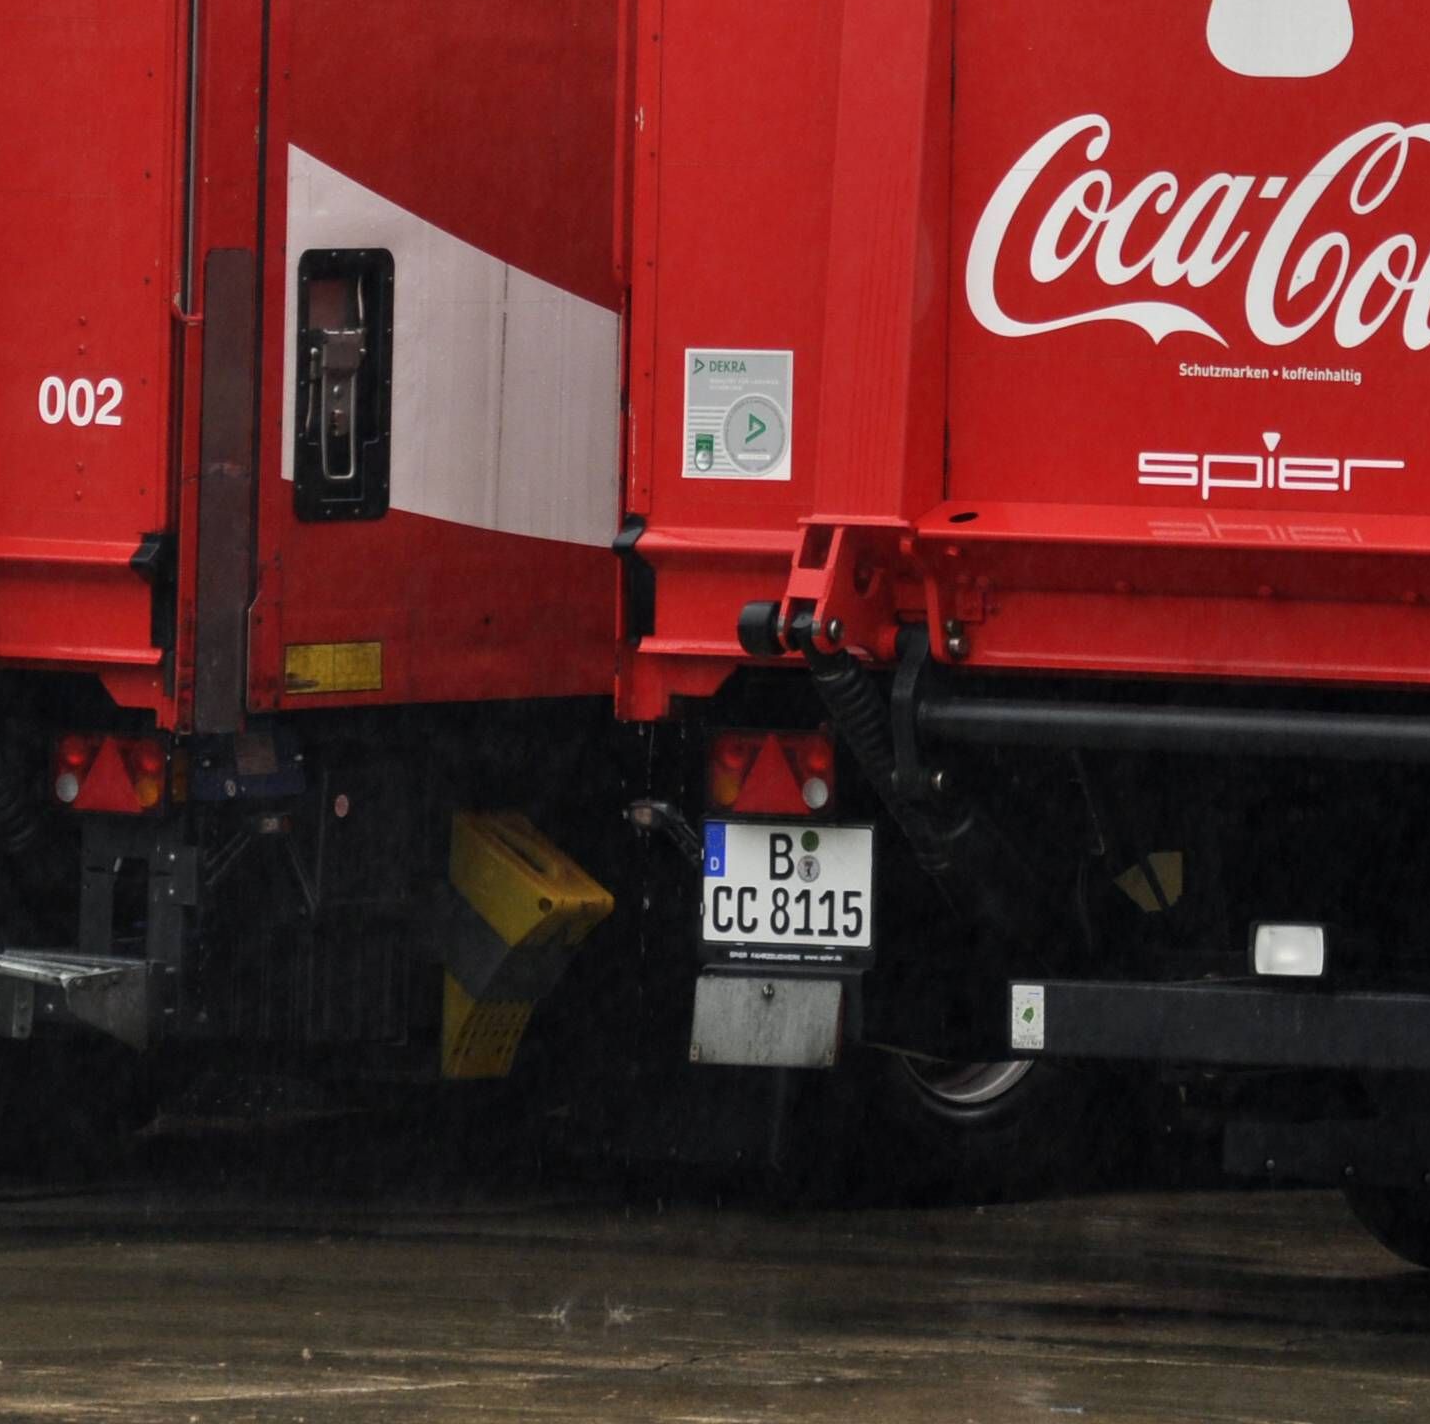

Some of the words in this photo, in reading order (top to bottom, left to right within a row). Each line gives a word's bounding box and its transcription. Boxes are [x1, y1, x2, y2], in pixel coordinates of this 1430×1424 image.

[709, 360, 747, 373] DEKRA
[1178, 362, 1269, 379] Schutzmarken
[1281, 366, 1362, 385] koffeinhaltig
[38, 375, 124, 427] 002
[1137, 431, 1405, 500] spier
[710, 857, 720, 871] D
[769, 832, 795, 881] B
[712, 885, 758, 934] CC
[770, 887, 863, 938] 8115
